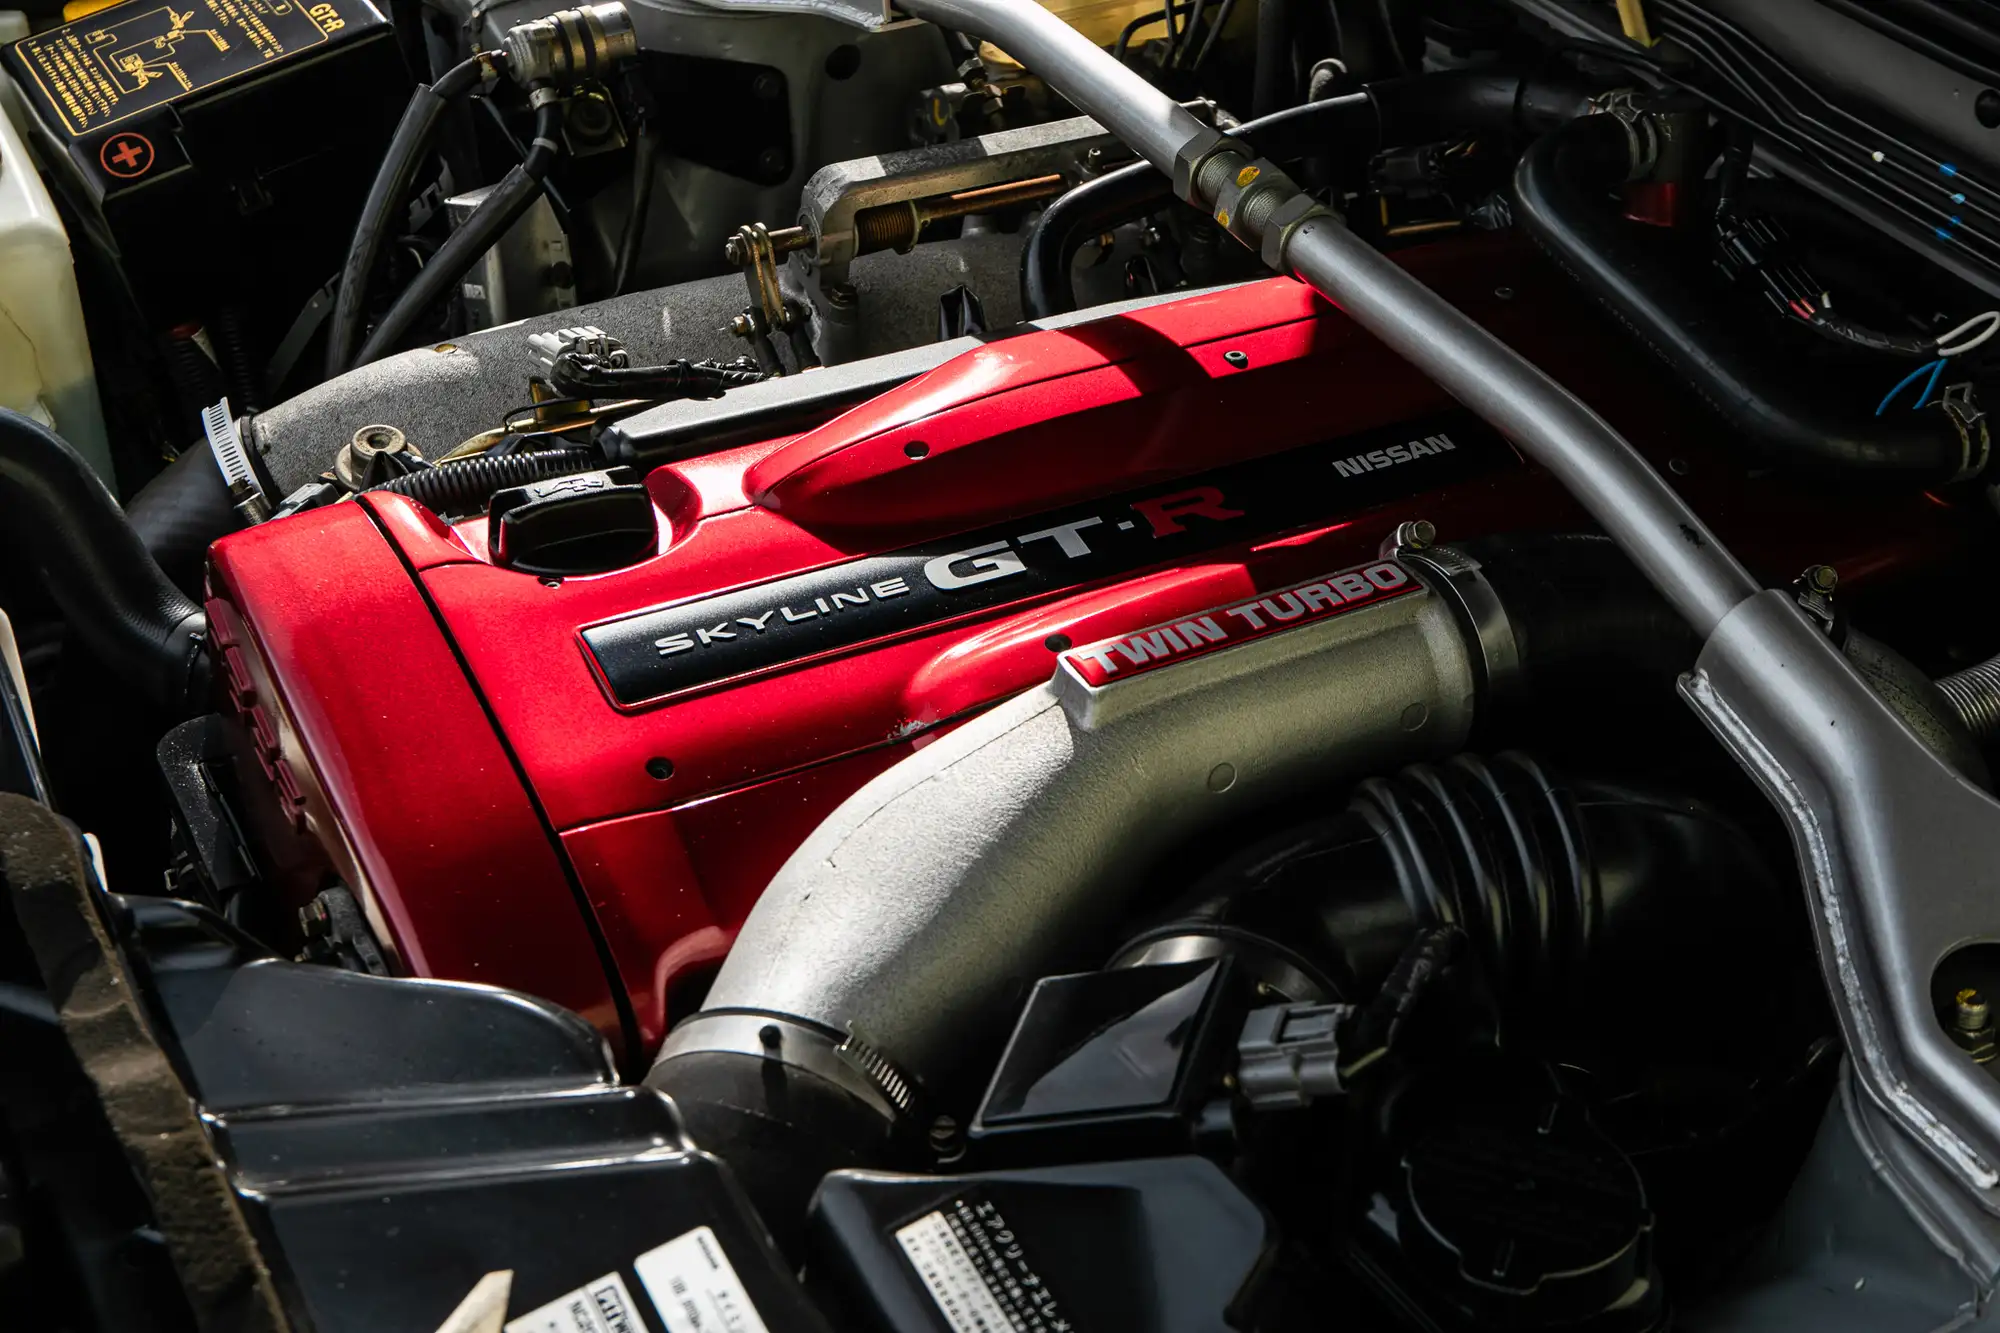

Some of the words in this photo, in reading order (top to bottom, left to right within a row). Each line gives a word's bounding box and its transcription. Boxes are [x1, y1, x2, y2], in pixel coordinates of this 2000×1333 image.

[655, 576, 910, 655] SKYLINE
[1332, 433, 1457, 478] NISSAN
[1078, 616, 1229, 675] TWIN
[1227, 563, 1408, 630] TURBO
[975, 1200, 1075, 1333] エアクリーナエレメ
